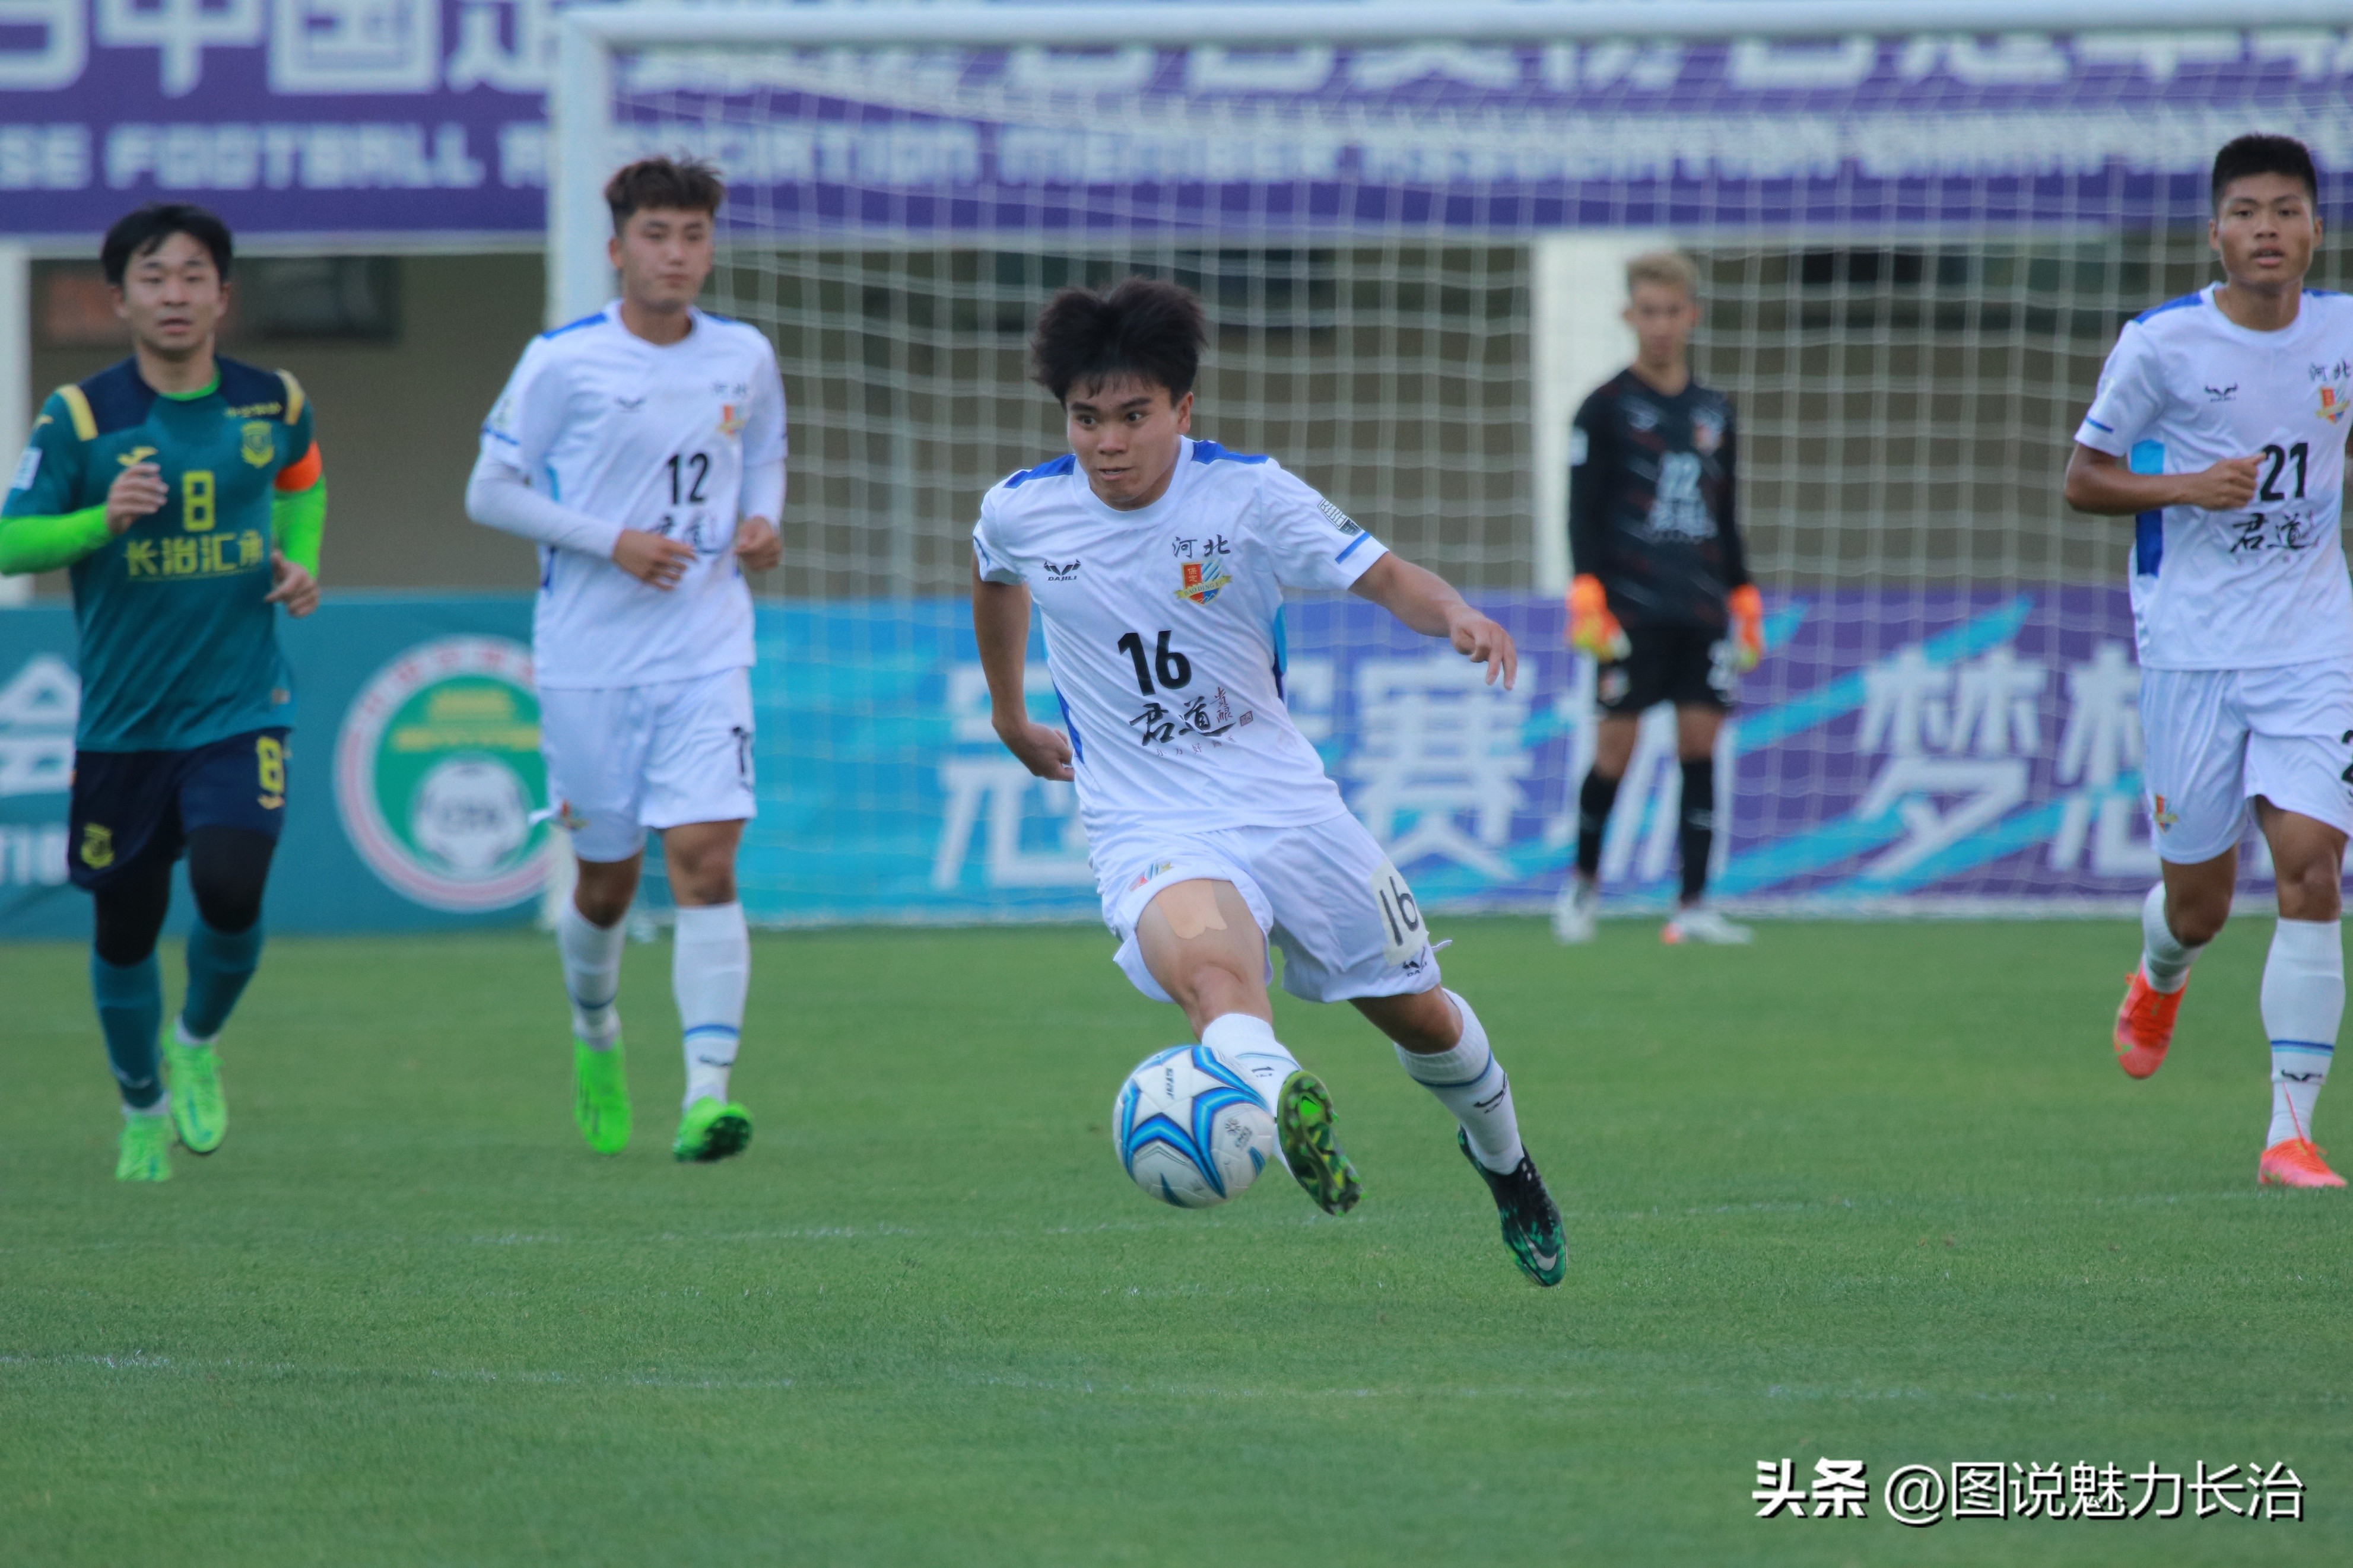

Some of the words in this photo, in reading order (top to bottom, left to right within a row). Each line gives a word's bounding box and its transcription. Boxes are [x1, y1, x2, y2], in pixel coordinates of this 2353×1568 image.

[106, 122, 484, 190] FOOTBALL
[182, 470, 215, 532] 8
[667, 452, 711, 505] 12
[2260, 442, 2308, 501] 21
[1172, 534, 1231, 559] 河北
[1198, 582, 1215, 591] DING
[1117, 630, 1192, 696] 16
[1129, 695, 1237, 746] 君道
[256, 735, 284, 794] 8
[1380, 876, 1420, 946] 16
